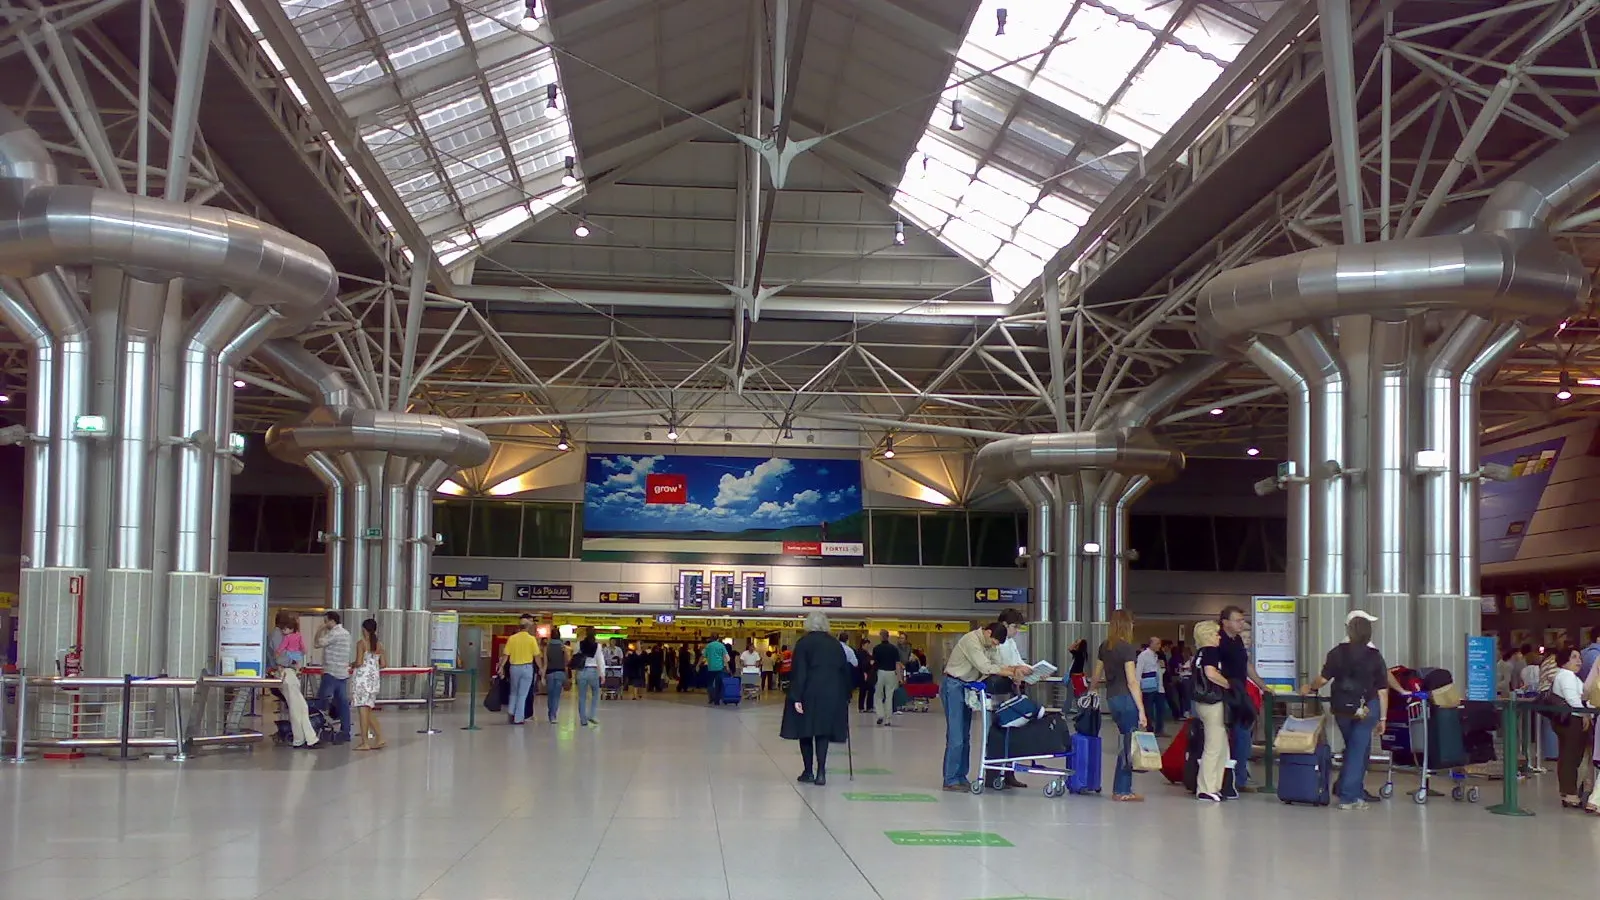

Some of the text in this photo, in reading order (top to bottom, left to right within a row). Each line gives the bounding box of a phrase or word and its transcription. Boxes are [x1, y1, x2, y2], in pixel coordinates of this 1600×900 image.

[654, 485, 678, 494] grow
[706, 619, 716, 627] 01
[723, 619, 732, 627] 13
[783, 620, 793, 628] 90
